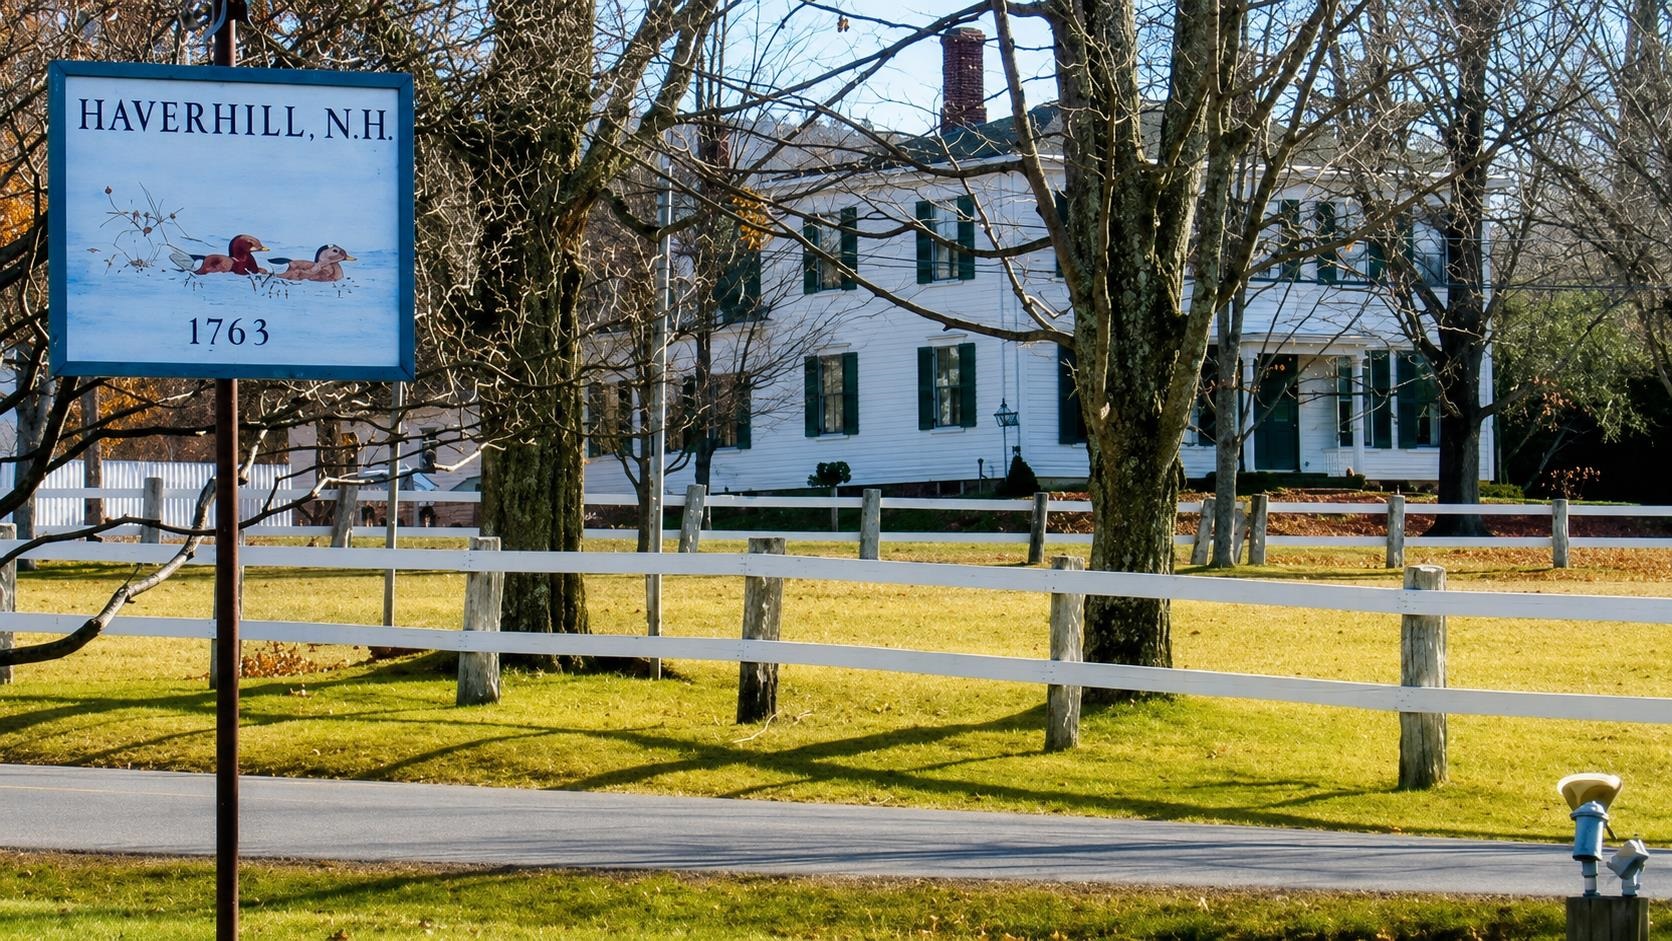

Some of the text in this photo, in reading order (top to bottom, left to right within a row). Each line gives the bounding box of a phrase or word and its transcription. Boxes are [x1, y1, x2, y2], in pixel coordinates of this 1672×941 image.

[78, 98, 394, 141] HAVERHILL, N.H.
[188, 317, 270, 346] 1763
